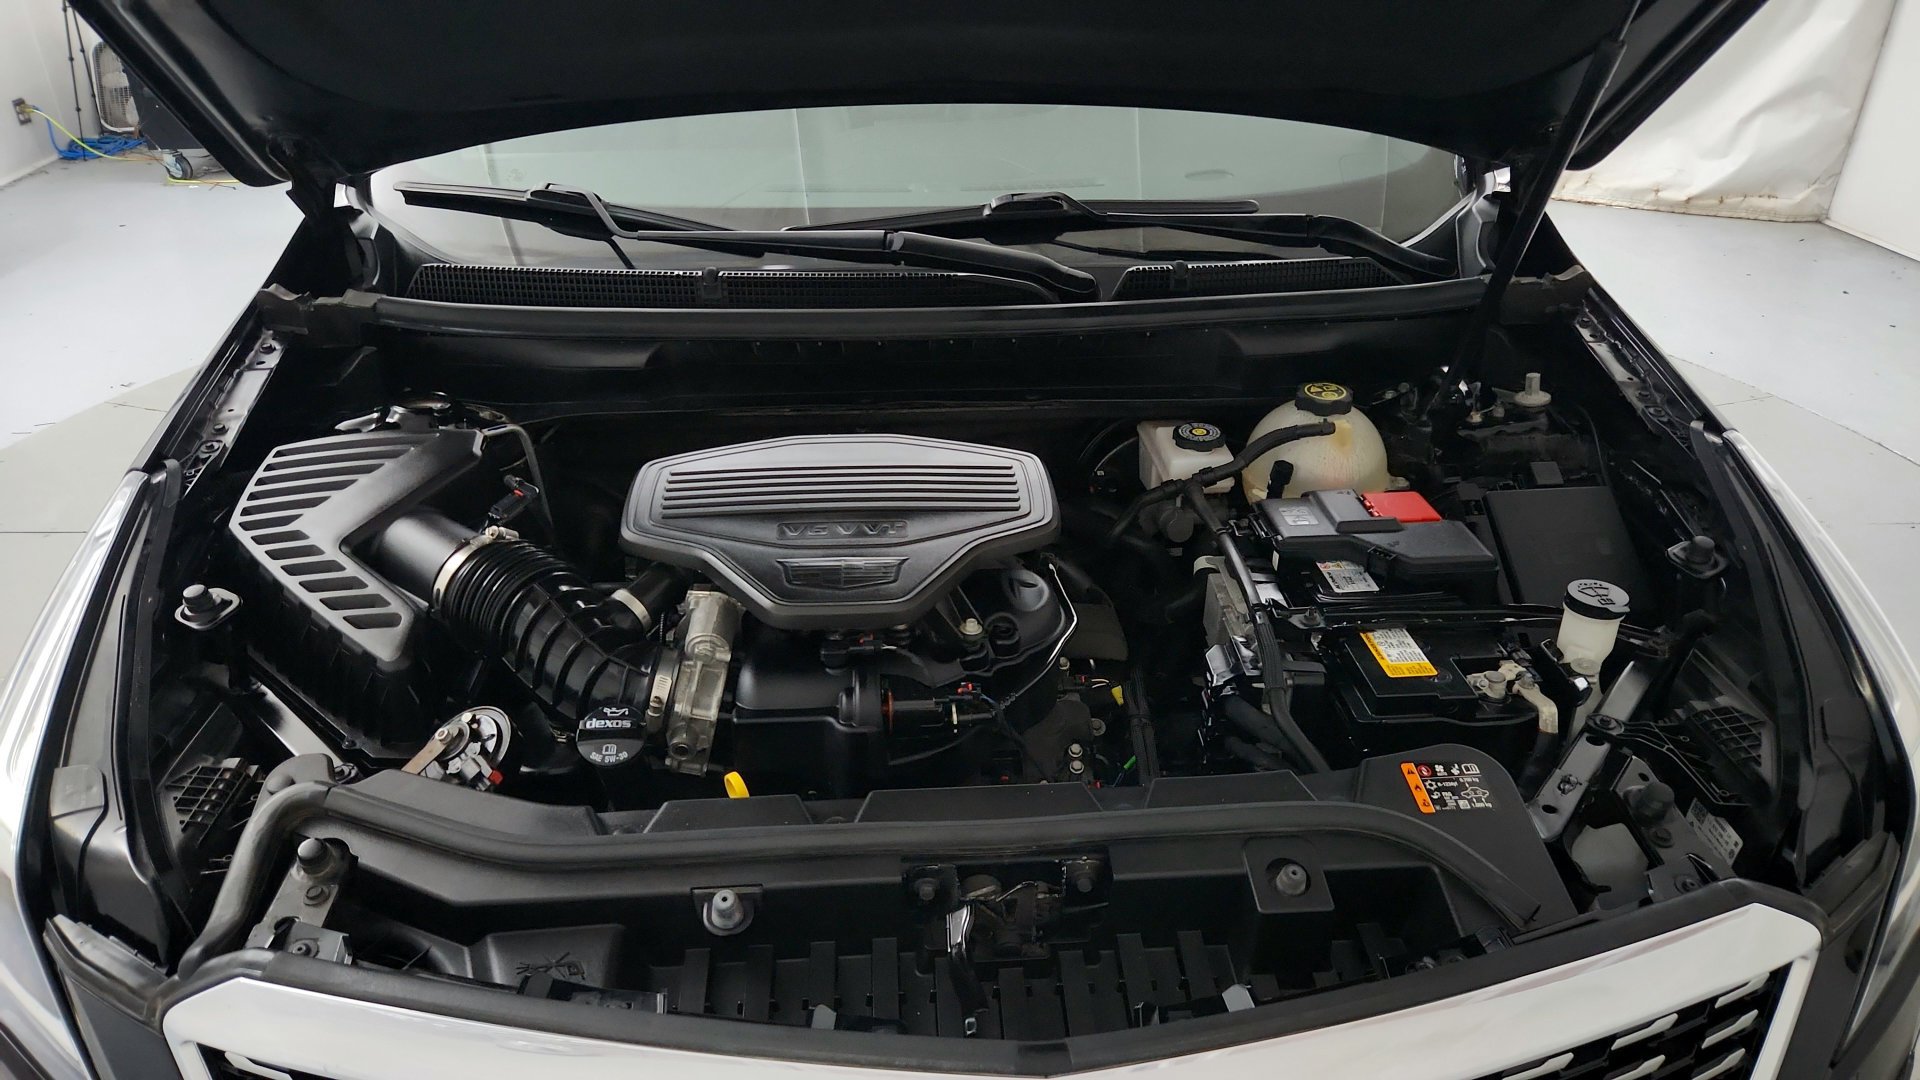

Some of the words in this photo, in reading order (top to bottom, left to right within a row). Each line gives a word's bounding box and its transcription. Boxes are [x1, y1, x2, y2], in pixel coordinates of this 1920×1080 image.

[782, 523, 828, 536] V6
[586, 718, 631, 729] dexos
[589, 751, 603, 762] SAE
[604, 751, 628, 763] 5W-30
